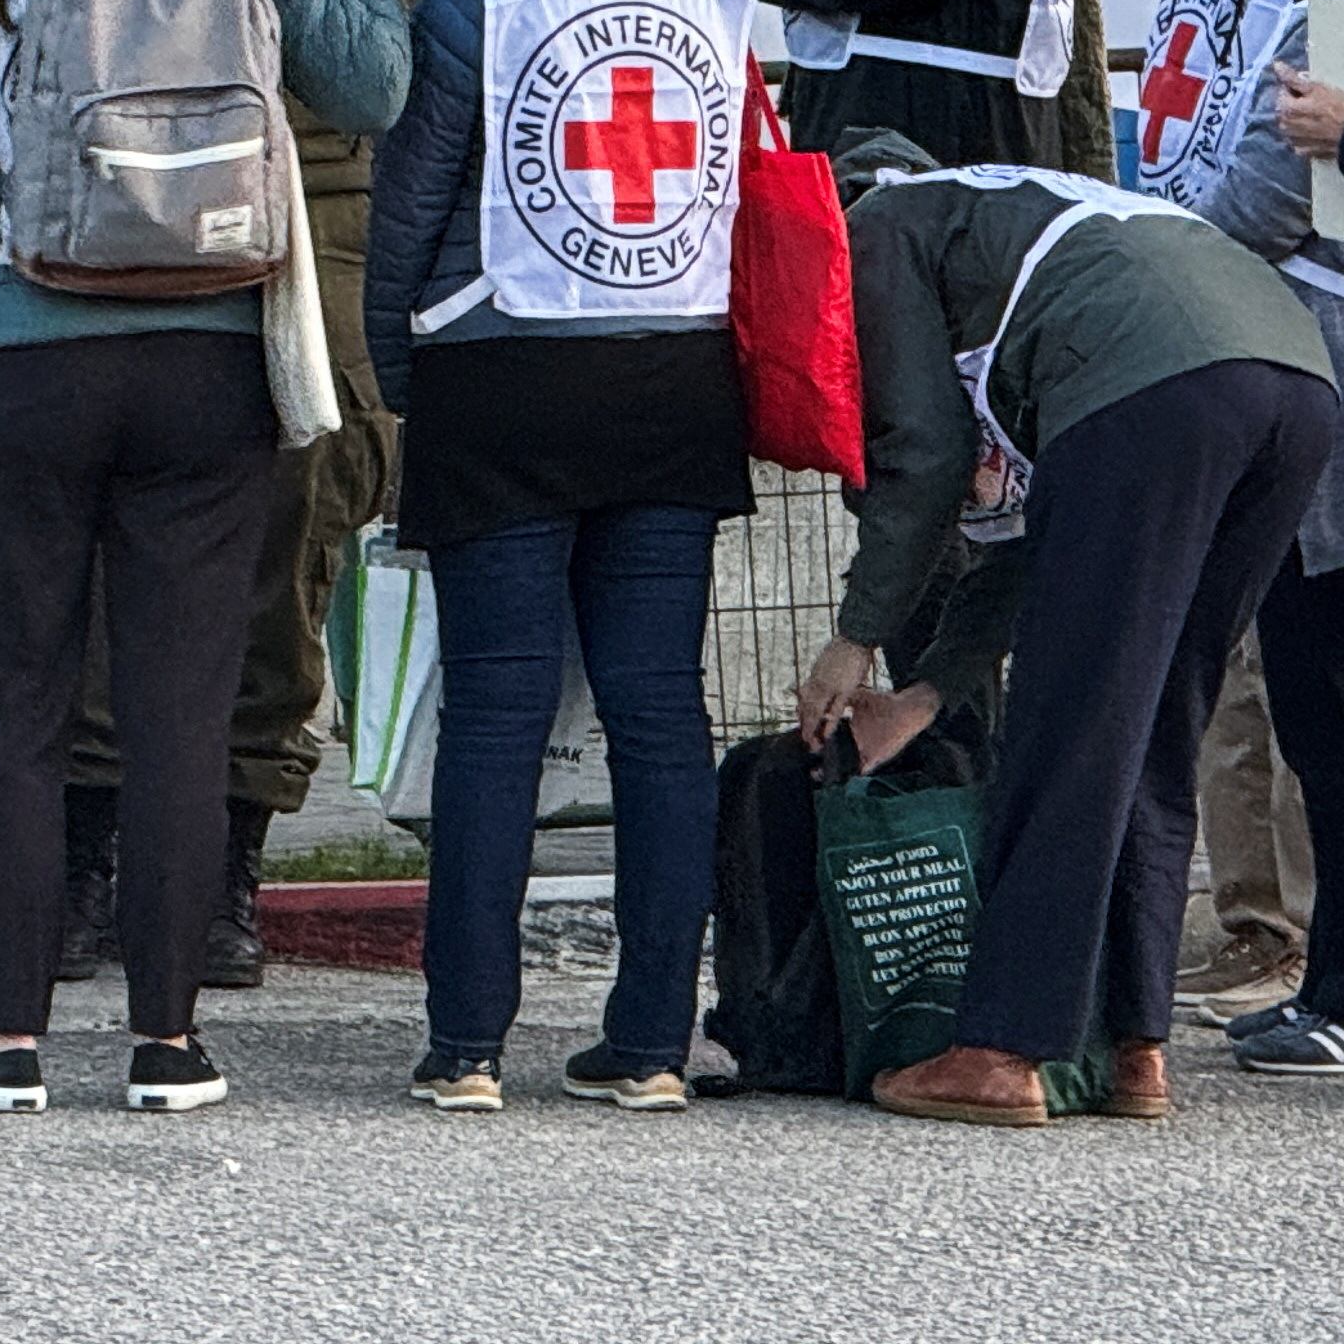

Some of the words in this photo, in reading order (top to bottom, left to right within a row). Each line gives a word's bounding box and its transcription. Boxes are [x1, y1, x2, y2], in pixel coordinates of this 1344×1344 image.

[514, 56, 569, 214] COMITE
[560, 226, 695, 278] GENEVE
[835, 873, 878, 893] ENJOY
[881, 866, 922, 885] YOUR
[923, 858, 966, 877] MEAL
[846, 891, 892, 911] GUTEN
[851, 912, 889, 929] BUEN
[889, 897, 967, 922] PROVECHO
[862, 929, 902, 947] BUON
